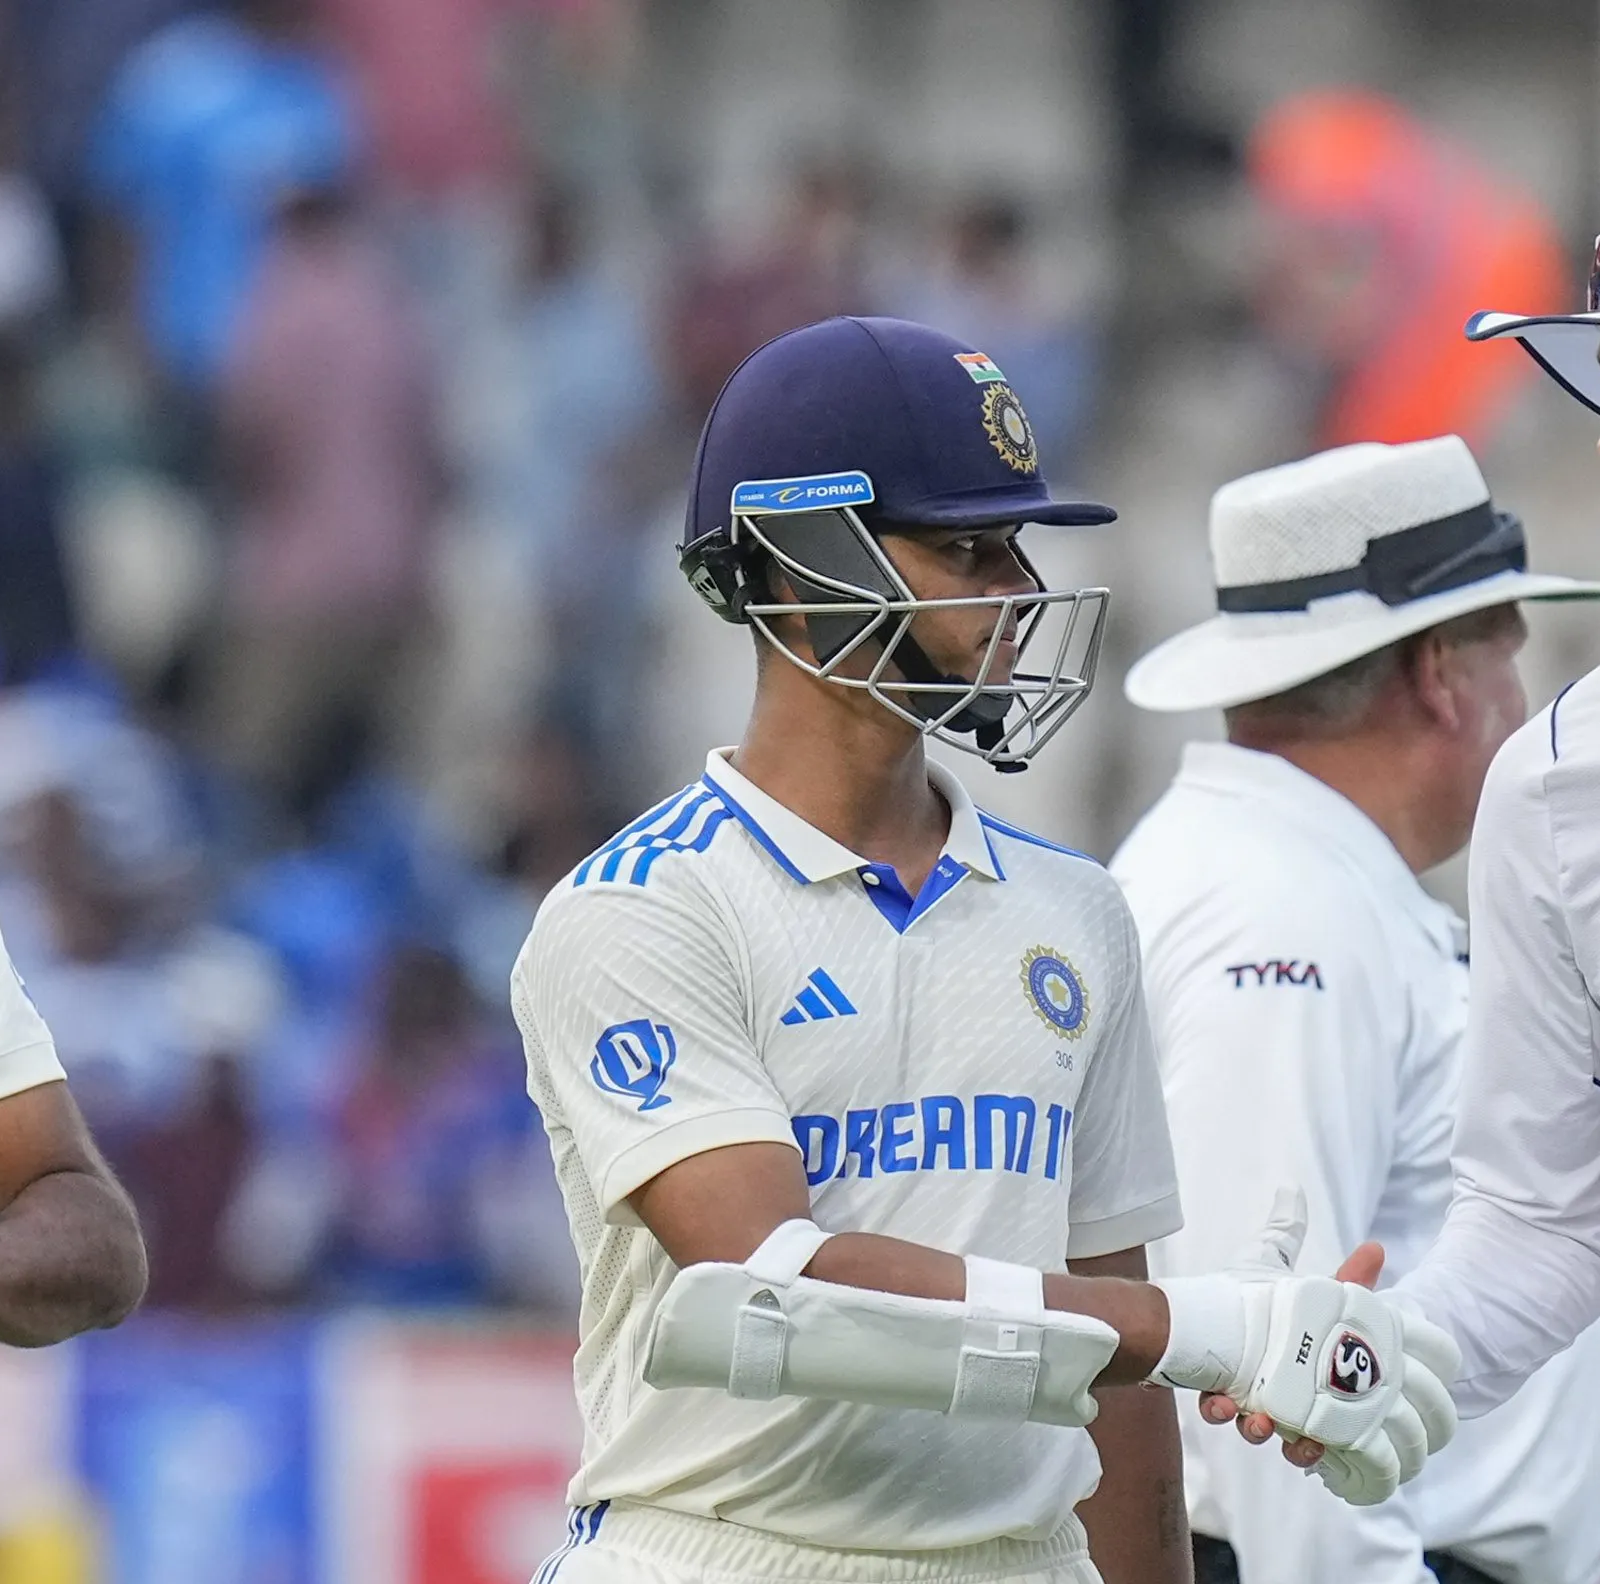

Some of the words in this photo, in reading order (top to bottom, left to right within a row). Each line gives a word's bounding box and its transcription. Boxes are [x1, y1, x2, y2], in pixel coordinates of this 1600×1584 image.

[806, 484, 865, 498] FORMA
[1226, 960, 1324, 990] TYKA
[1055, 1050, 1073, 1071] 306
[1296, 1331, 1314, 1366] TEST
